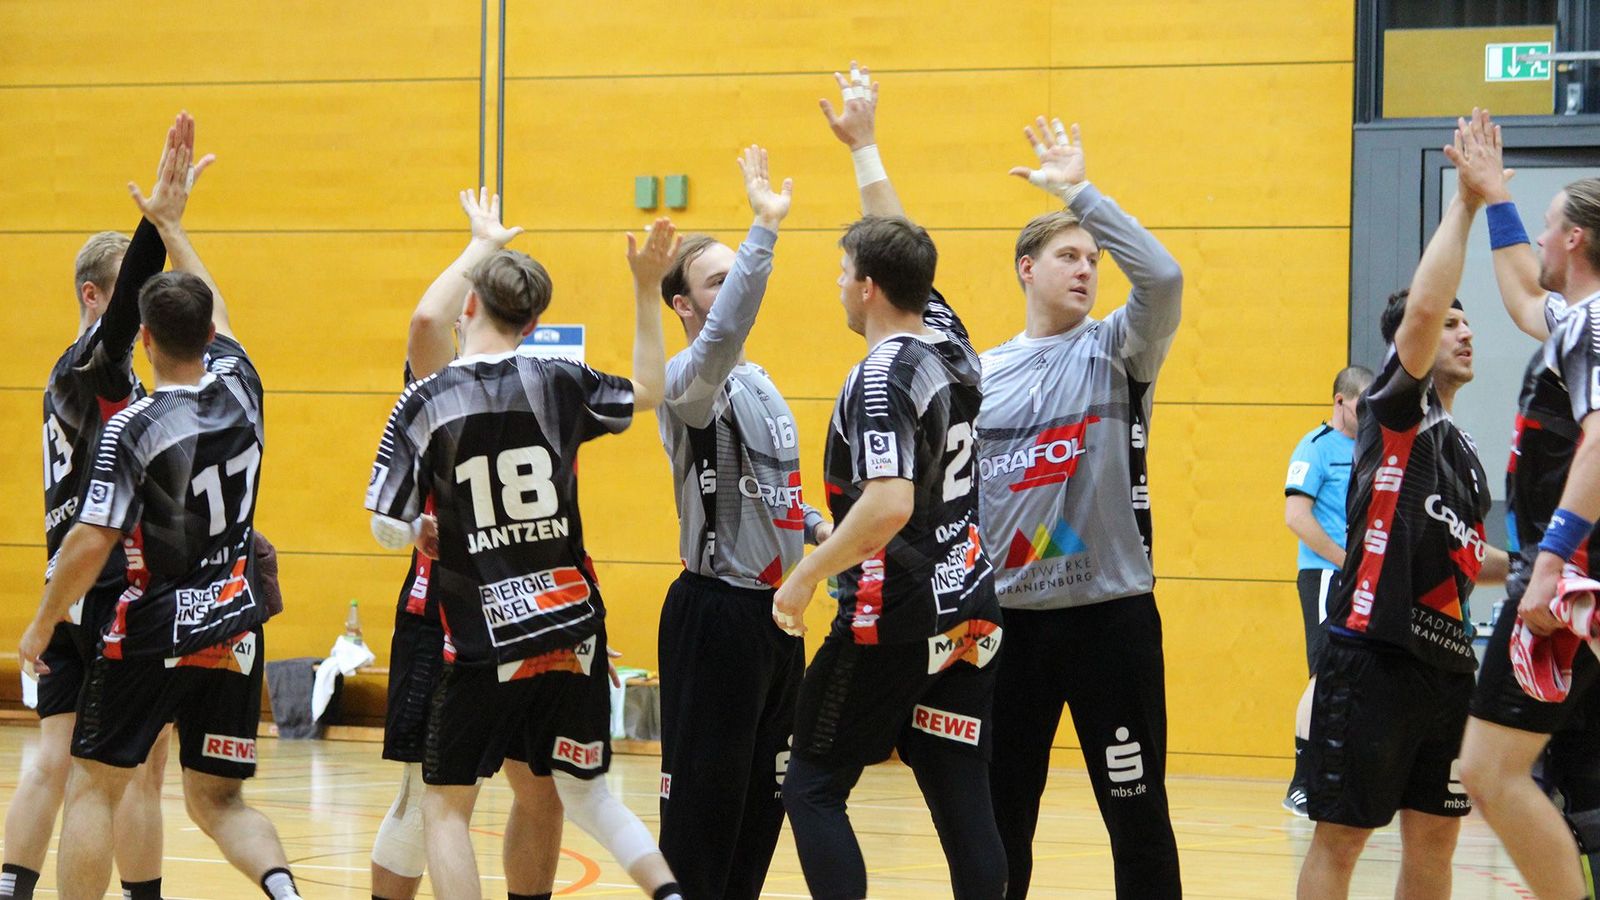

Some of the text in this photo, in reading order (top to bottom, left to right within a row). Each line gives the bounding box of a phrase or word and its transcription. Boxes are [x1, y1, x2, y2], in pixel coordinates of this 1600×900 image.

[1028, 380, 1043, 414] 1
[942, 419, 978, 504] 2
[978, 436, 1088, 482] ORAFOL
[191, 440, 261, 537] 17
[454, 444, 559, 529] 18
[467, 516, 570, 555] JANTZEN
[998, 572, 1093, 596] ORANIENBURG
[1003, 556, 1092, 584] ADTWERKE
[482, 572, 554, 605] ENERGIE
[484, 599, 538, 625] INSEL
[1411, 607, 1468, 643] STADTW
[915, 707, 977, 741] REWE
[1110, 783, 1147, 798] mbs.de
